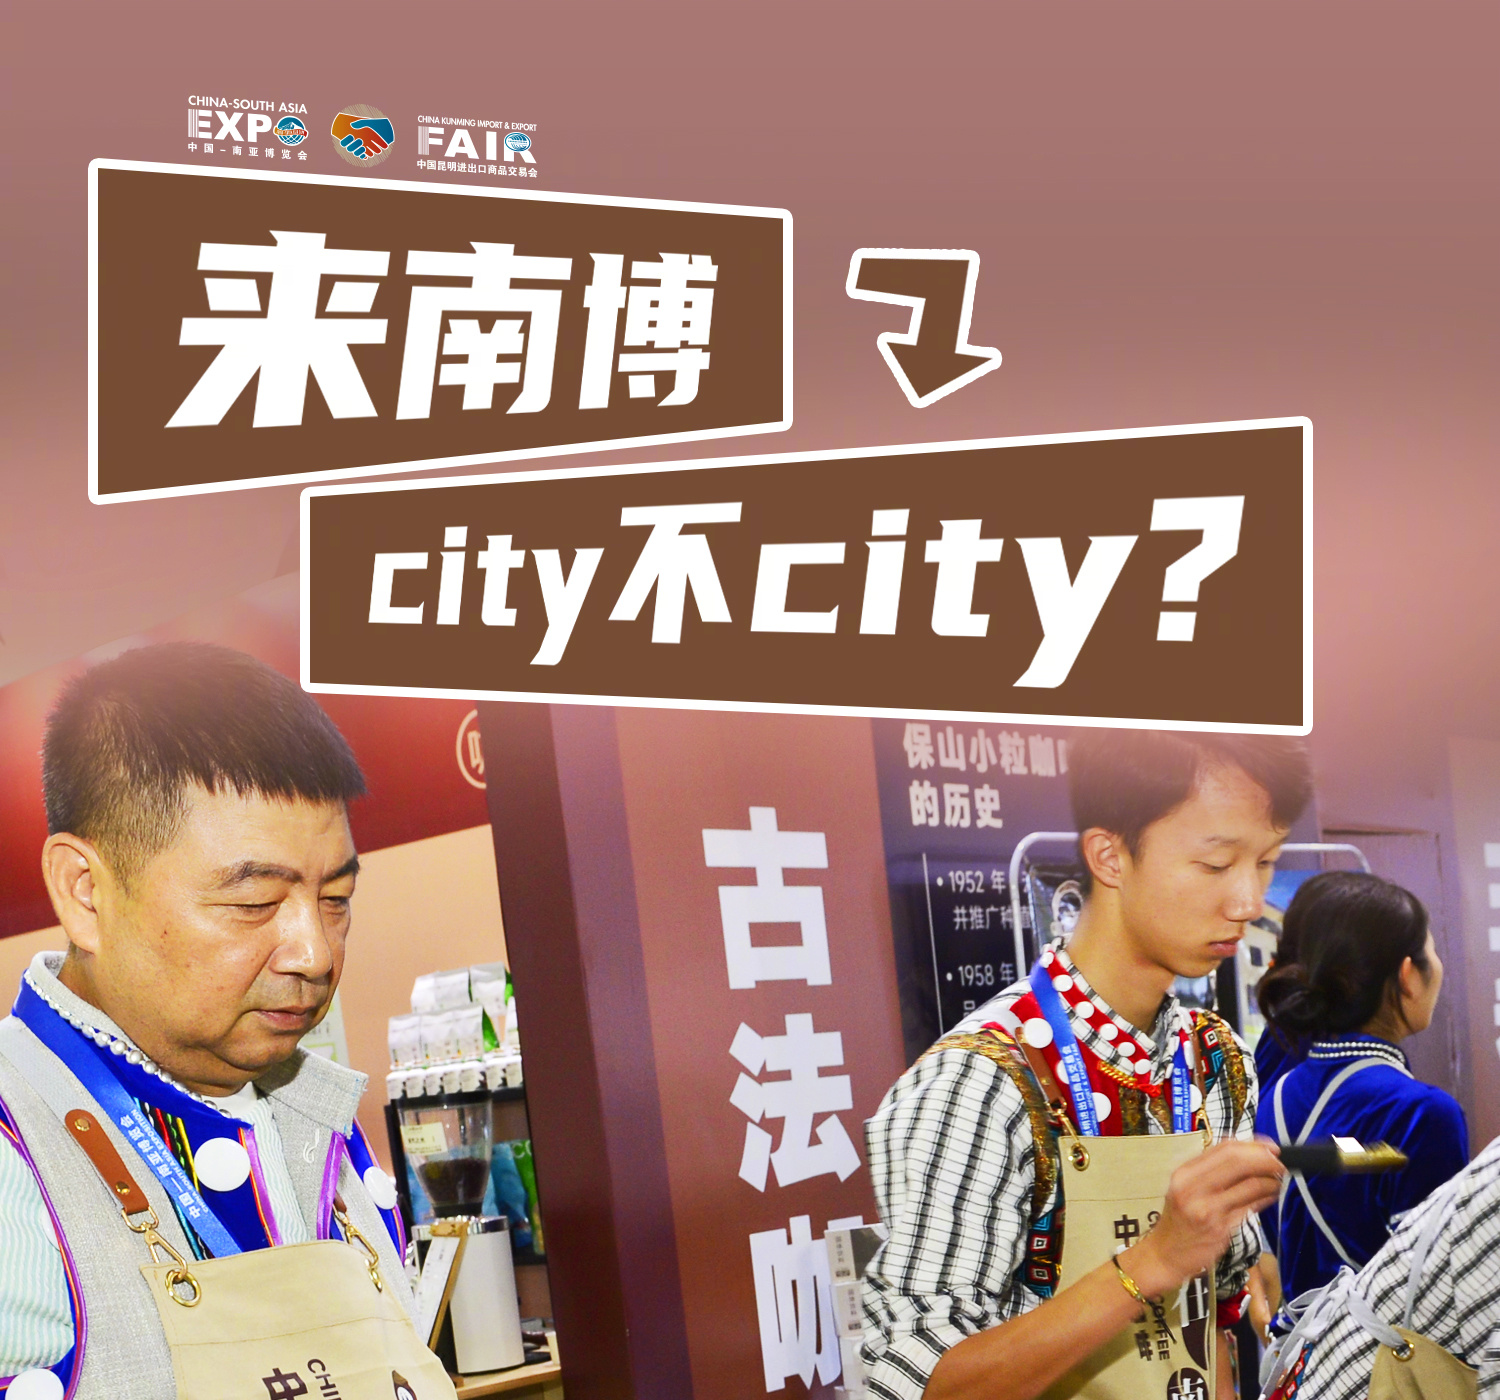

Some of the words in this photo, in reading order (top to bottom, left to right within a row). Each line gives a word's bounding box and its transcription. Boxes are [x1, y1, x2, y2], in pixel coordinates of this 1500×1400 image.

[909, 780, 1003, 829] 的历史
[948, 870, 985, 893] 1952
[958, 964, 994, 986] 1958
[131, 1109, 164, 1150] EXPOSITION
[160, 1149, 177, 1168] ASIA
